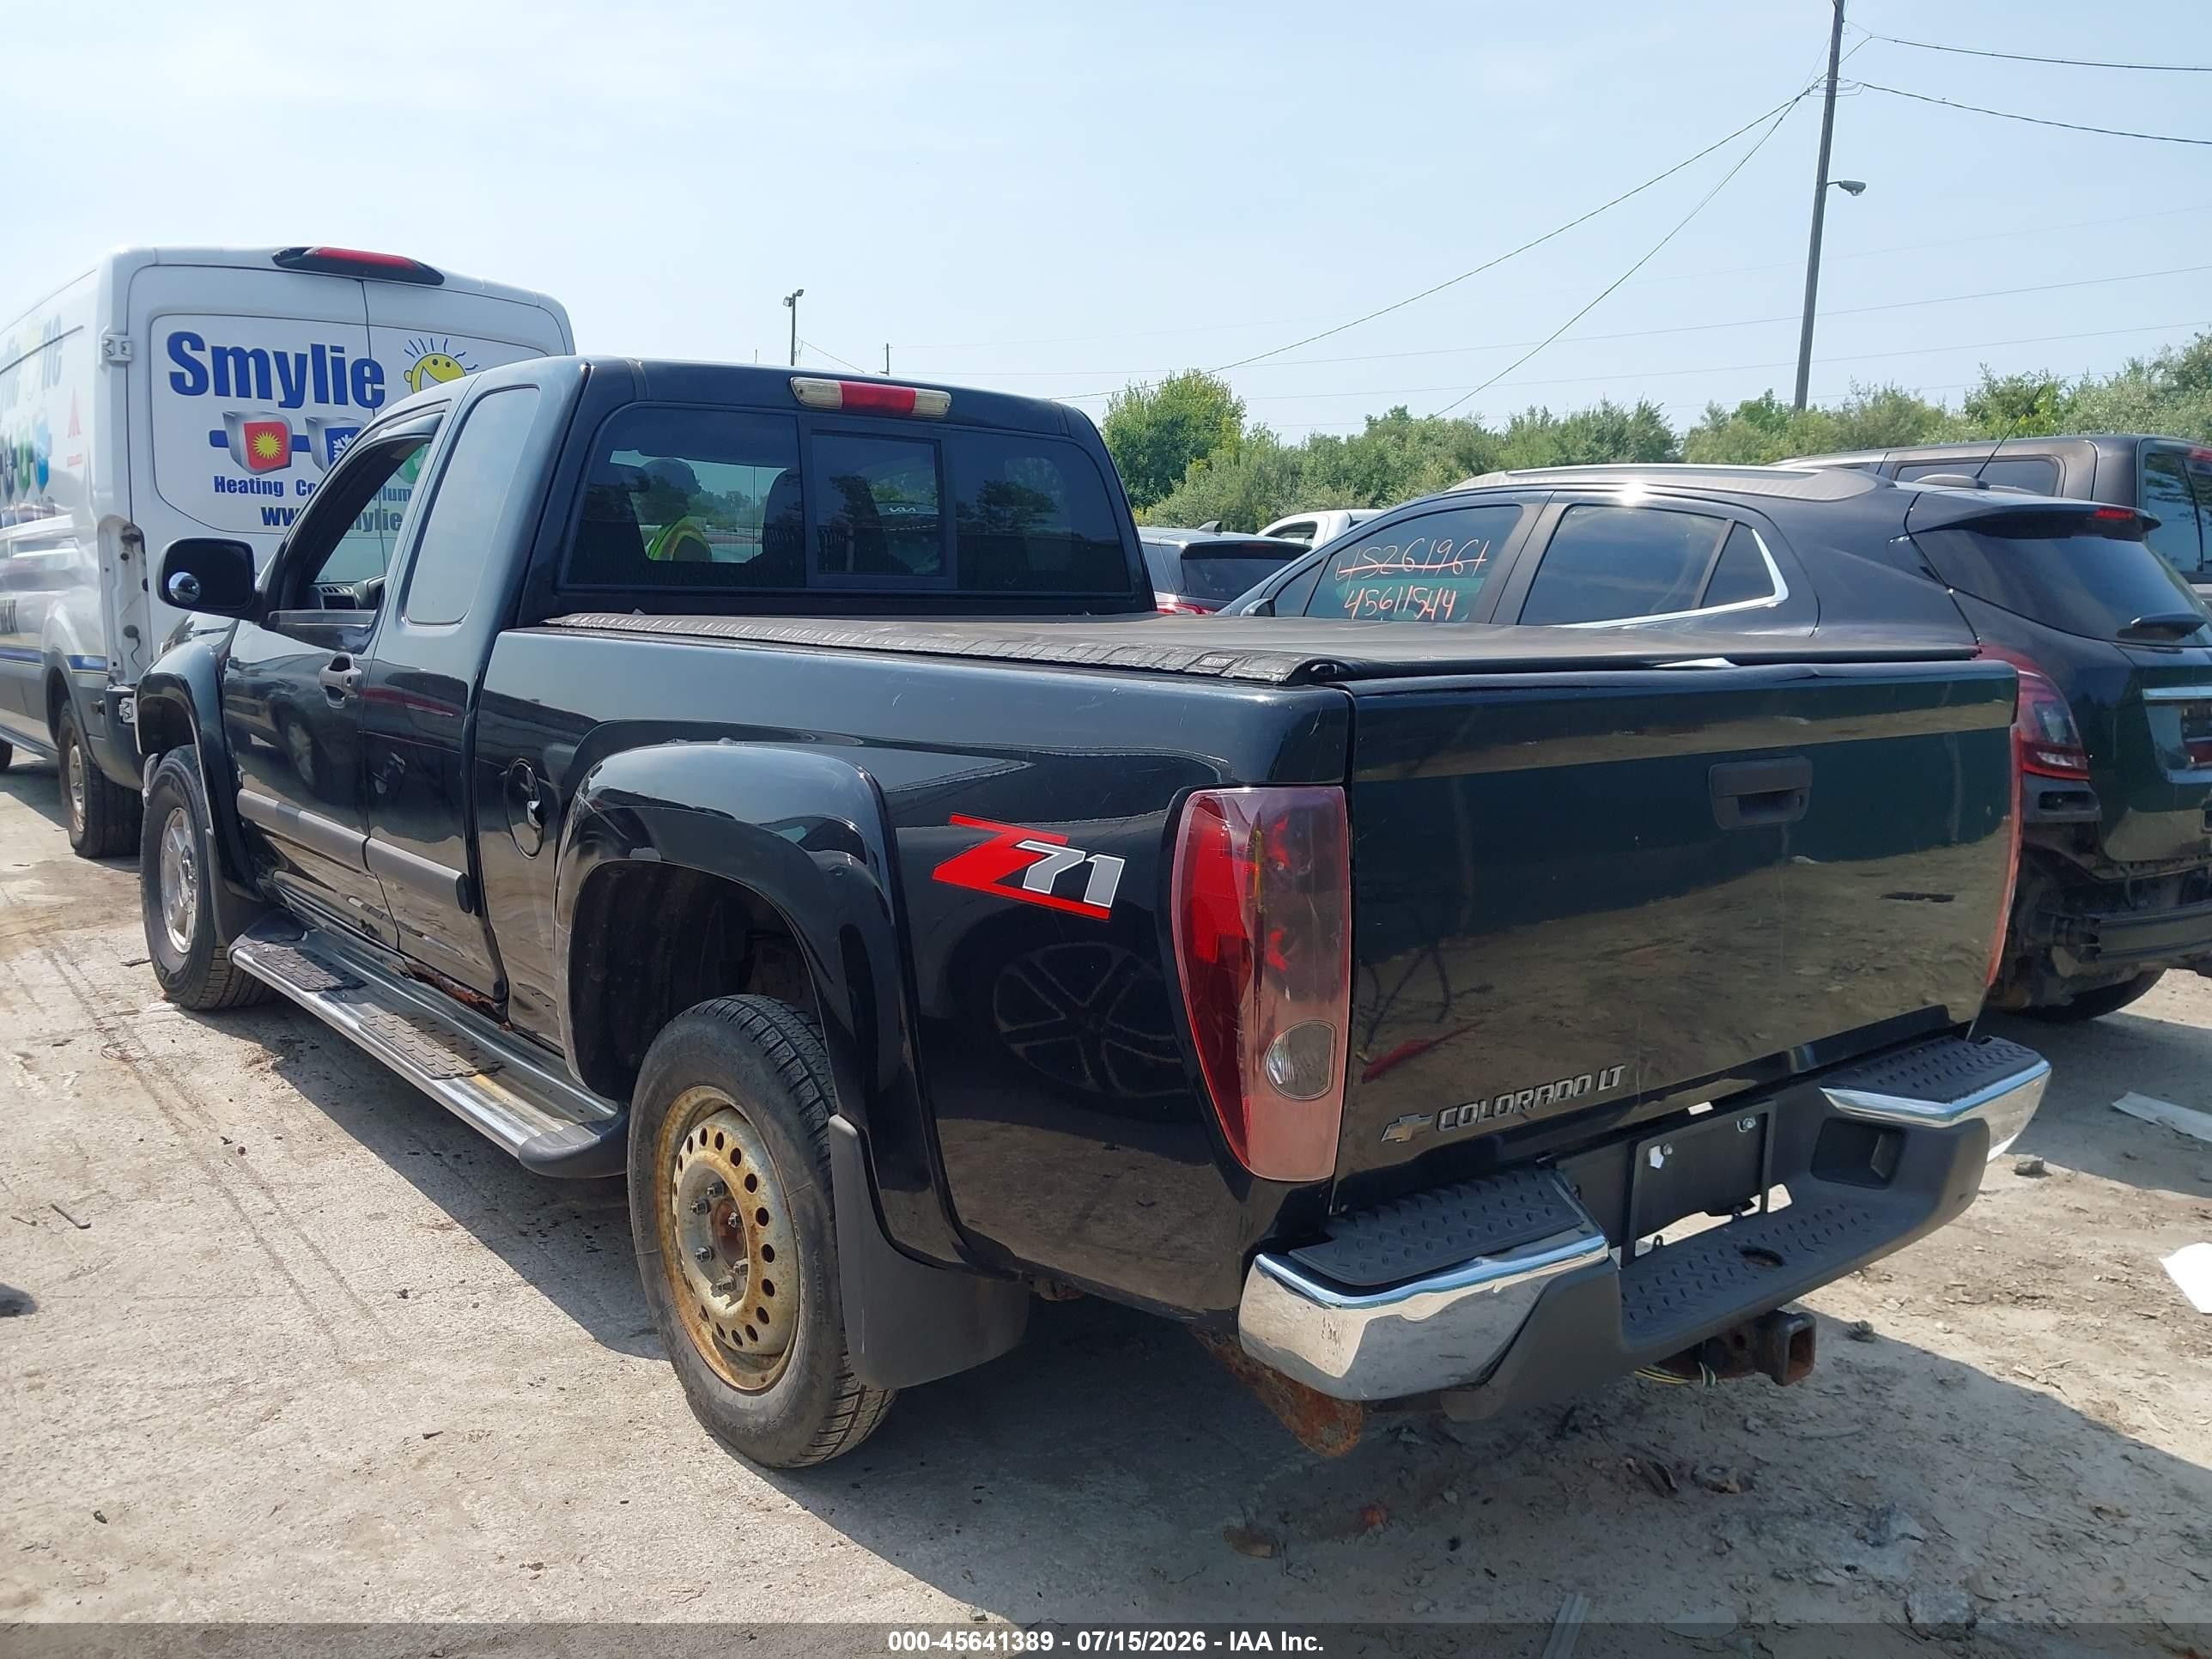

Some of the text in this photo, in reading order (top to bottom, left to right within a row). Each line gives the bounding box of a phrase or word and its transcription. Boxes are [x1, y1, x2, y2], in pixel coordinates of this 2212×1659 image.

[167, 331, 386, 409] Smylie
[214, 476, 284, 497] Heating
[933, 812, 1126, 922] Z71
[1437, 1064, 1626, 1133] COLORADO LT
